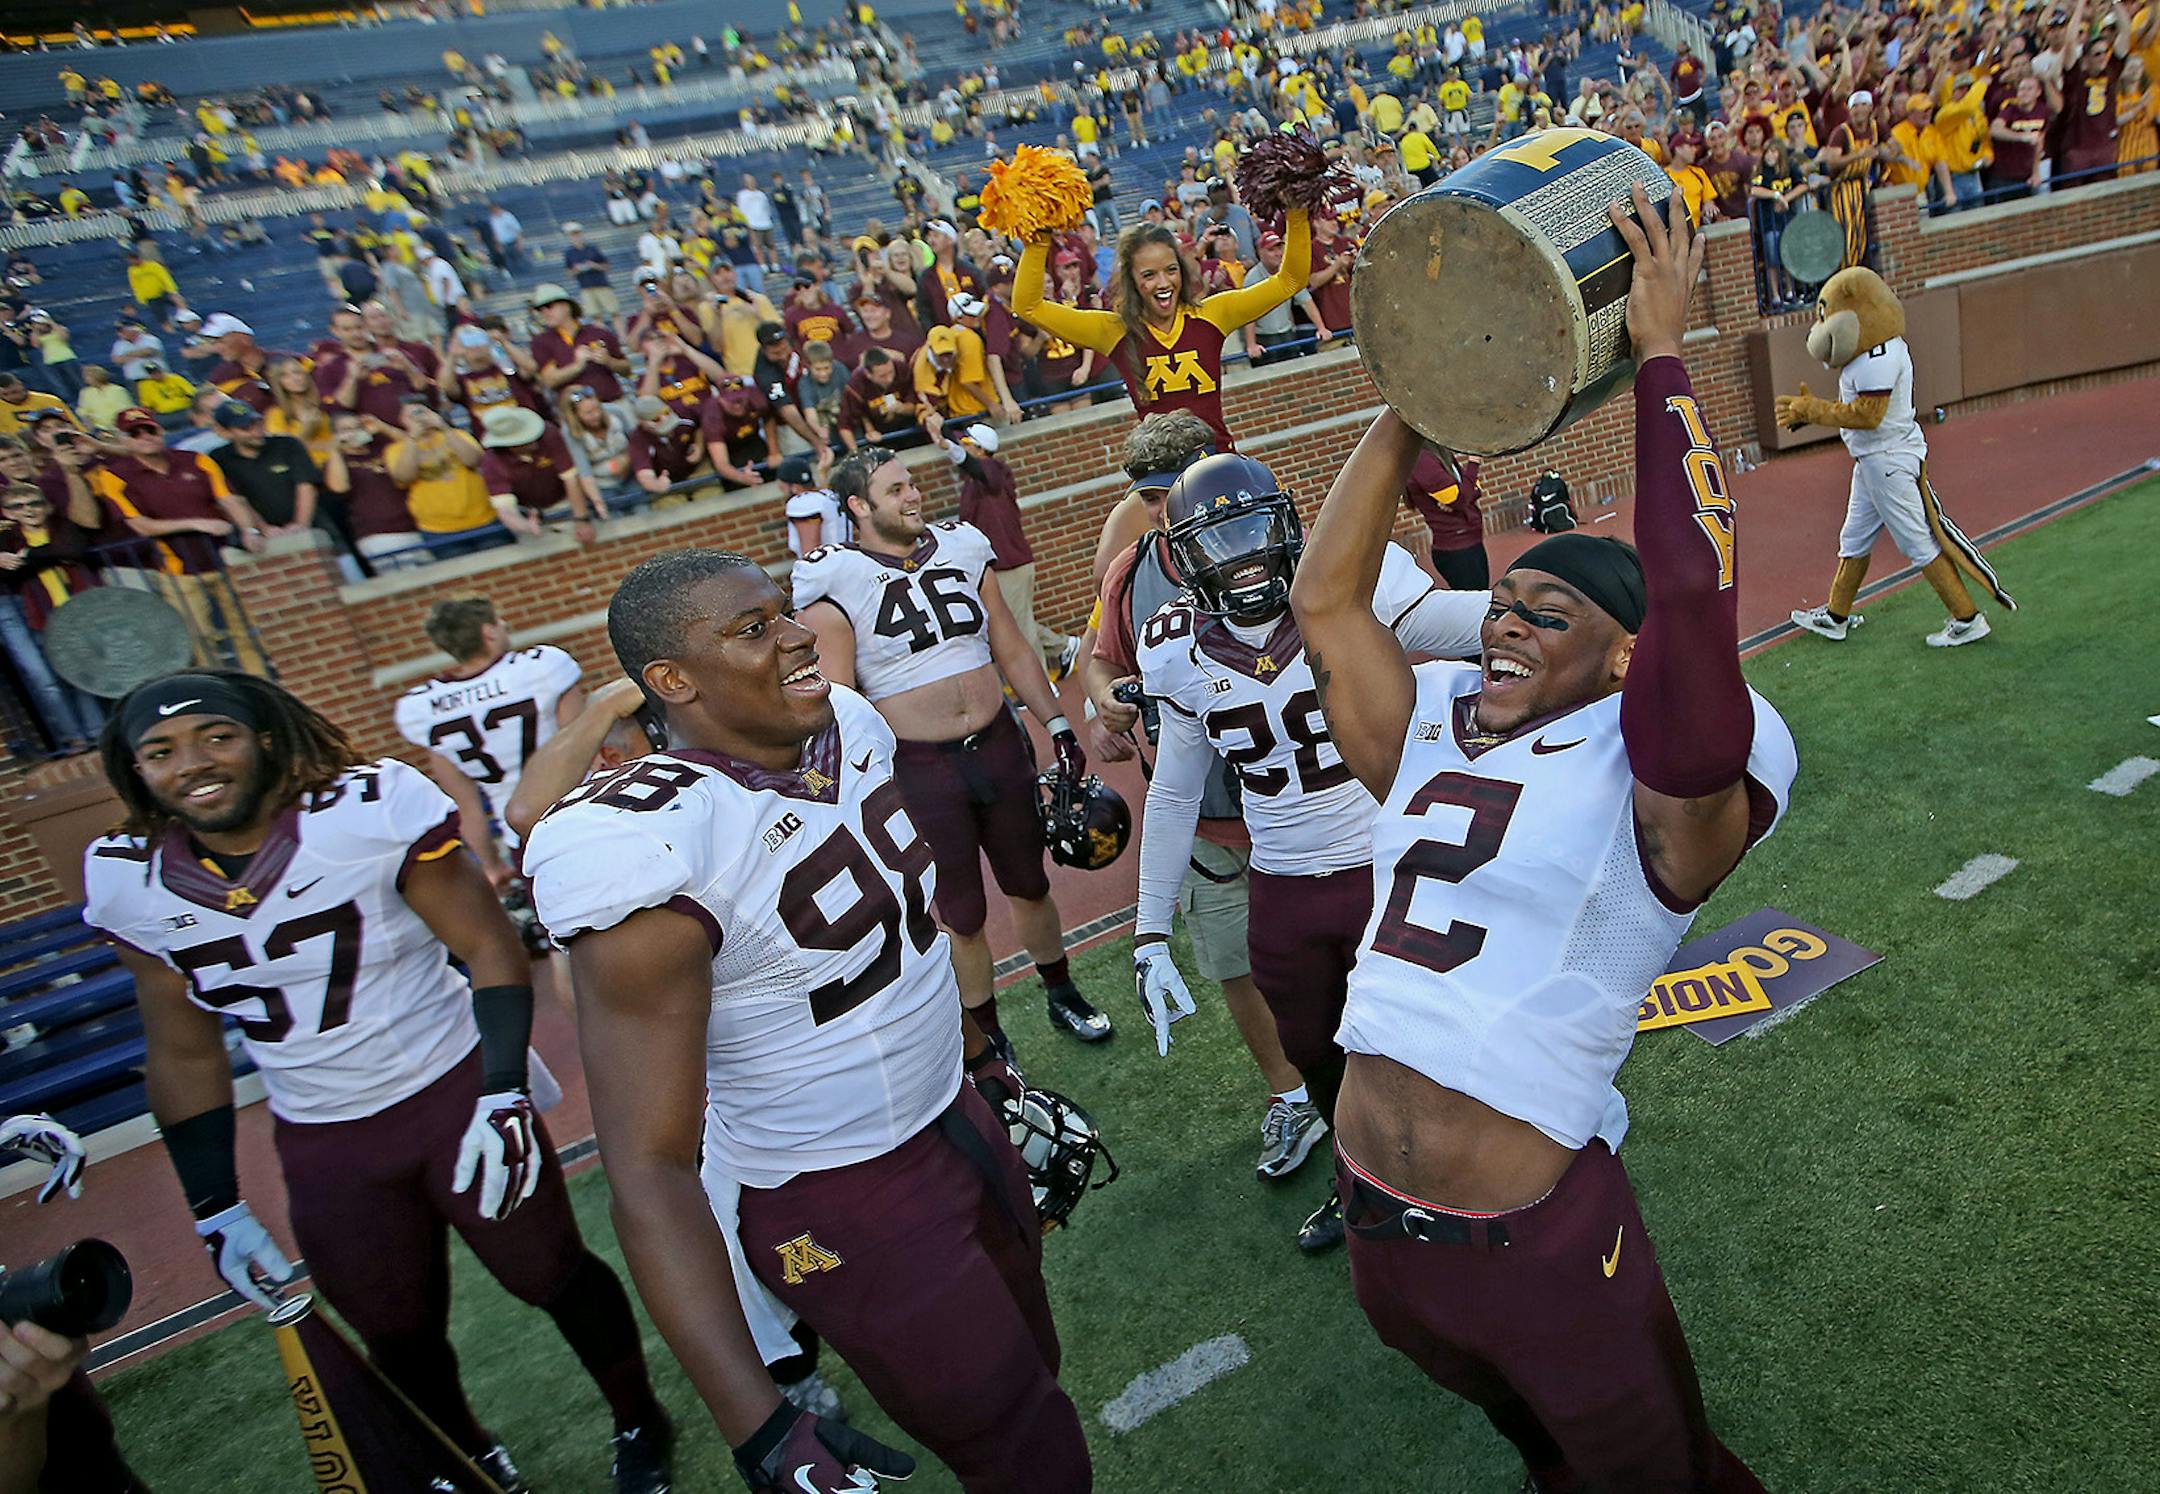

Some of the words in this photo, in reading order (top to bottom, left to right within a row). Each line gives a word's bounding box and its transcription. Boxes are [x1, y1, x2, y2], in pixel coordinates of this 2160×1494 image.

[1144, 350, 1217, 401] M
[873, 568, 985, 655] 46
[1253, 654, 1279, 676] M
[430, 678, 509, 716] MORTELL
[430, 697, 539, 784] 37
[1202, 689, 1353, 797] 28
[801, 767, 835, 797] M
[762, 811, 805, 853] BIG
[226, 886, 259, 911] M
[1370, 771, 1526, 973] 2
[777, 776, 939, 1028] 98
[168, 899, 365, 1043] 57
[1726, 928, 1838, 979] GO
[771, 1230, 845, 1287] M
